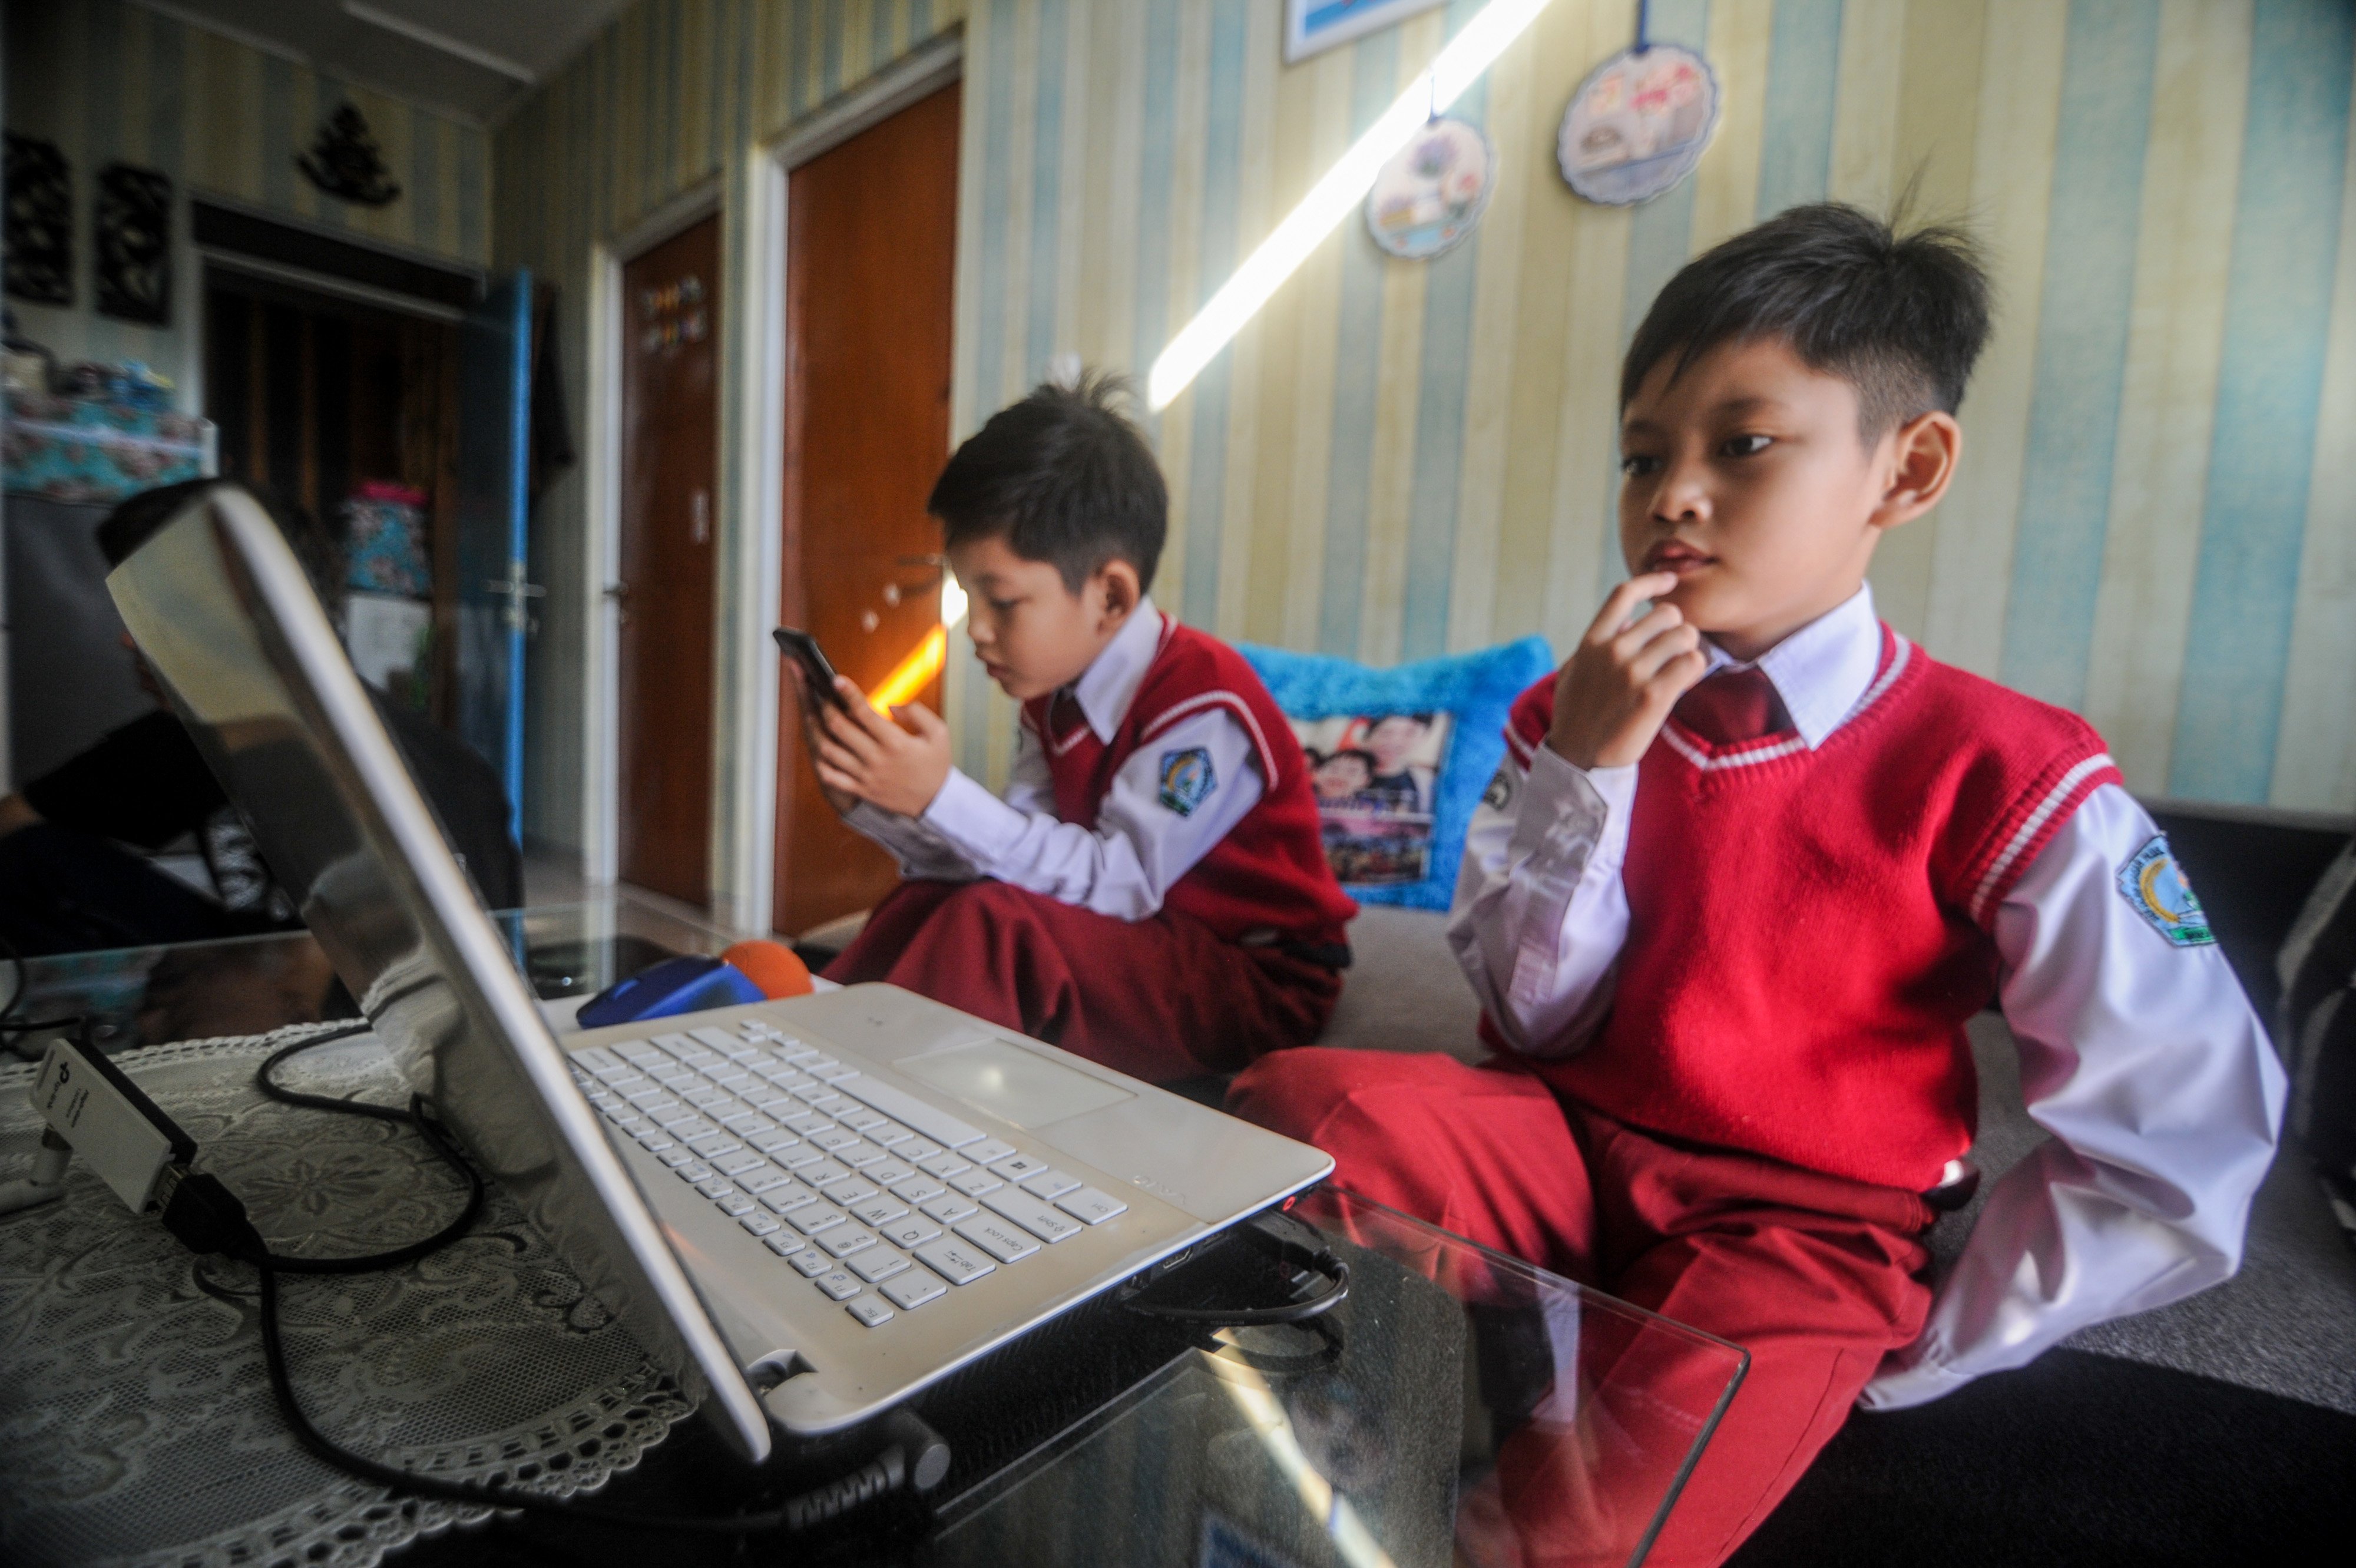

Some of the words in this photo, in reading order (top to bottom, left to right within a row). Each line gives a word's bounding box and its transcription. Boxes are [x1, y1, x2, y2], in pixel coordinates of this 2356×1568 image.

[968, 1183, 985, 1191] Z
[842, 1192, 859, 1200] E
[942, 1208, 958, 1216] A
[1091, 1203, 1108, 1213] Ctrl
[867, 1209, 887, 1220] W
[1037, 1215, 1055, 1227] Shift
[902, 1230, 919, 1240] Q
[985, 1228, 1004, 1239] Lock
[837, 1241, 852, 1249] @
[1002, 1239, 1023, 1251] Caps
[960, 1261, 976, 1272] Tab
[864, 1307, 878, 1318] Esc
